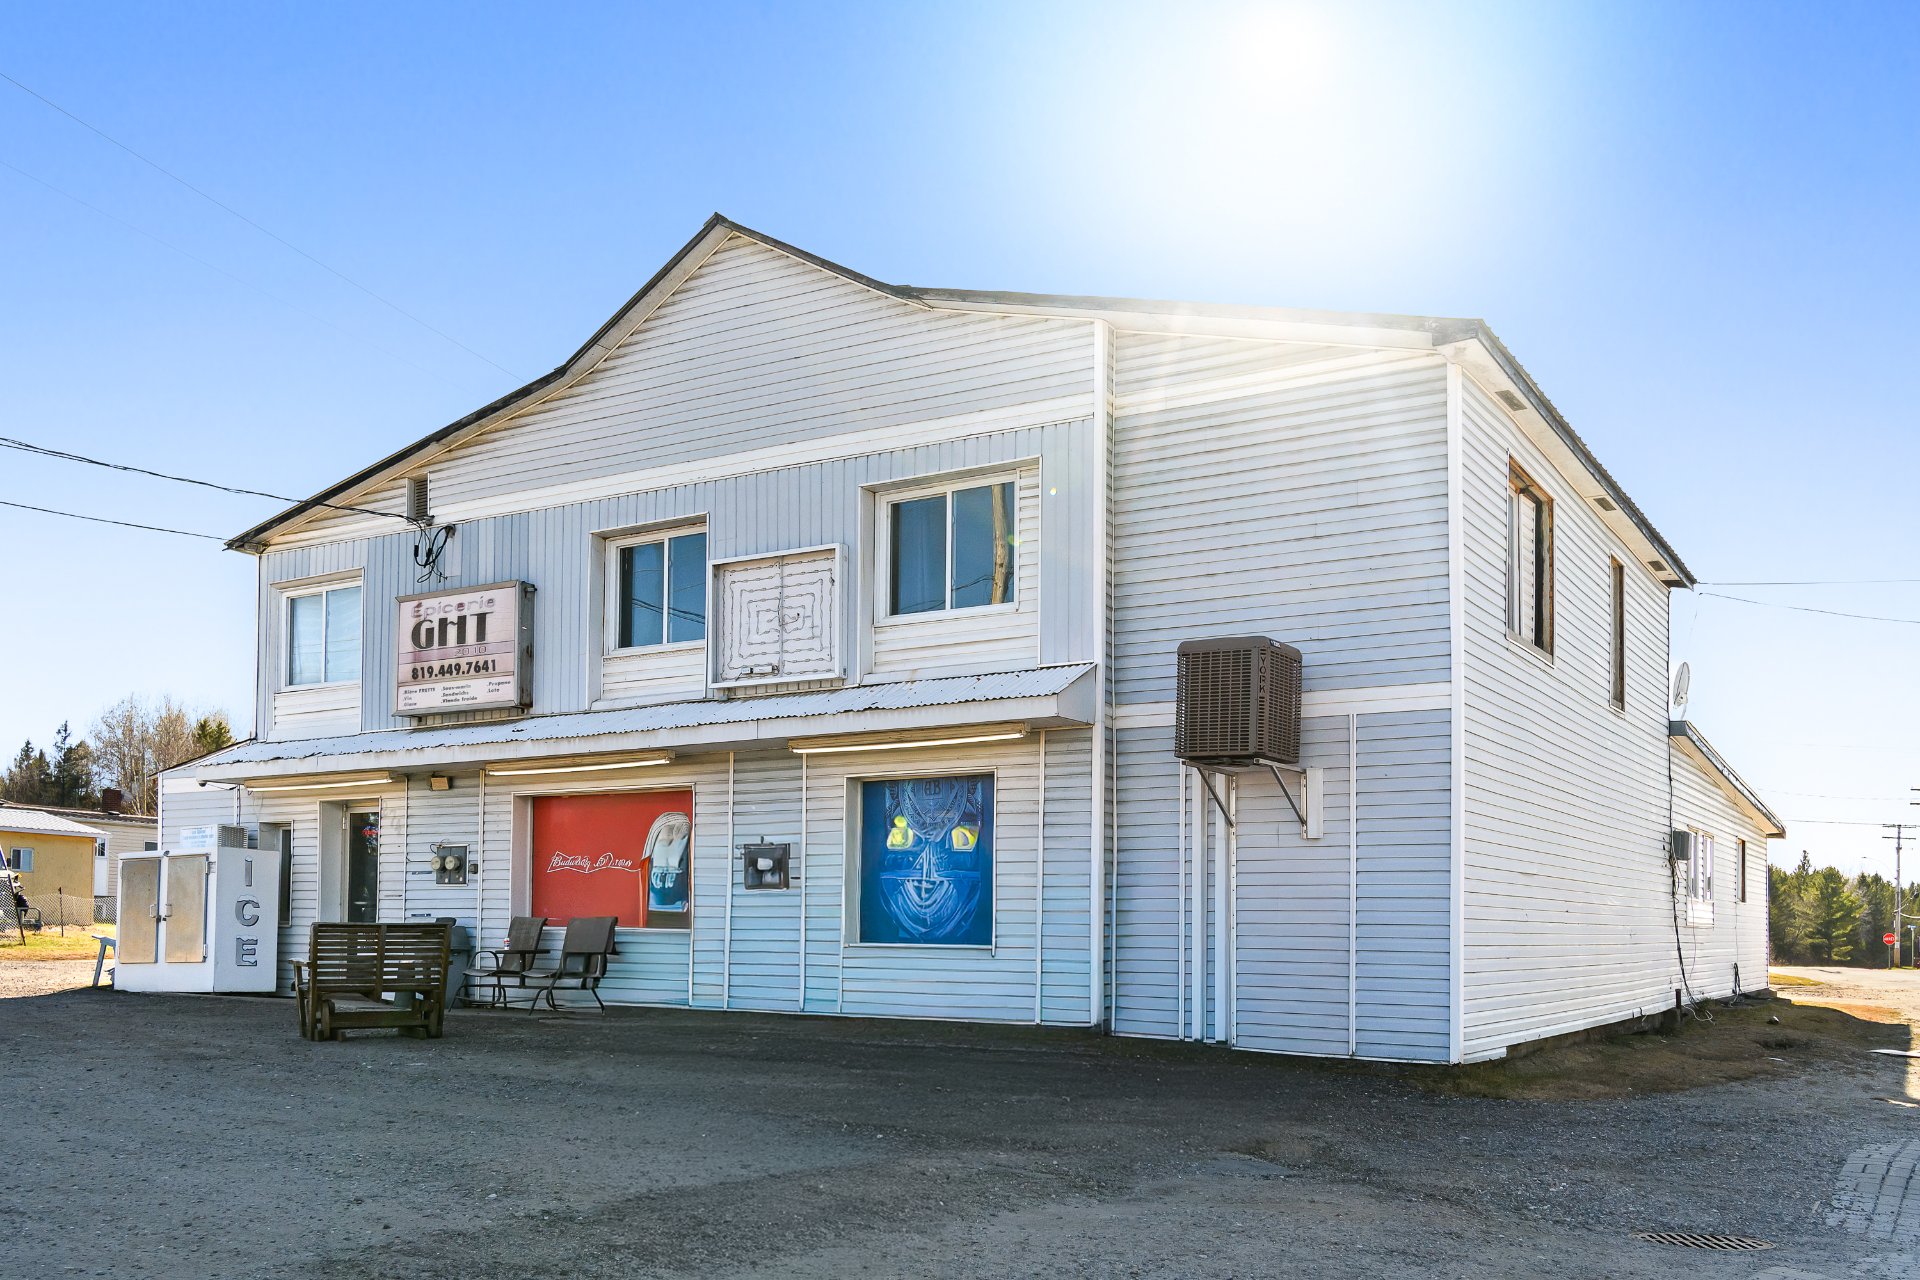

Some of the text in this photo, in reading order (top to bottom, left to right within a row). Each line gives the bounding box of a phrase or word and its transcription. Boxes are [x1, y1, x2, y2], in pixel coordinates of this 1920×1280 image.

[411, 596, 495, 619] Épicerie
[411, 611, 494, 649] GHT
[411, 659, 496, 680] 819.449.7641
[1259, 656, 1267, 693] YORK
[235, 855, 261, 968] ICE
